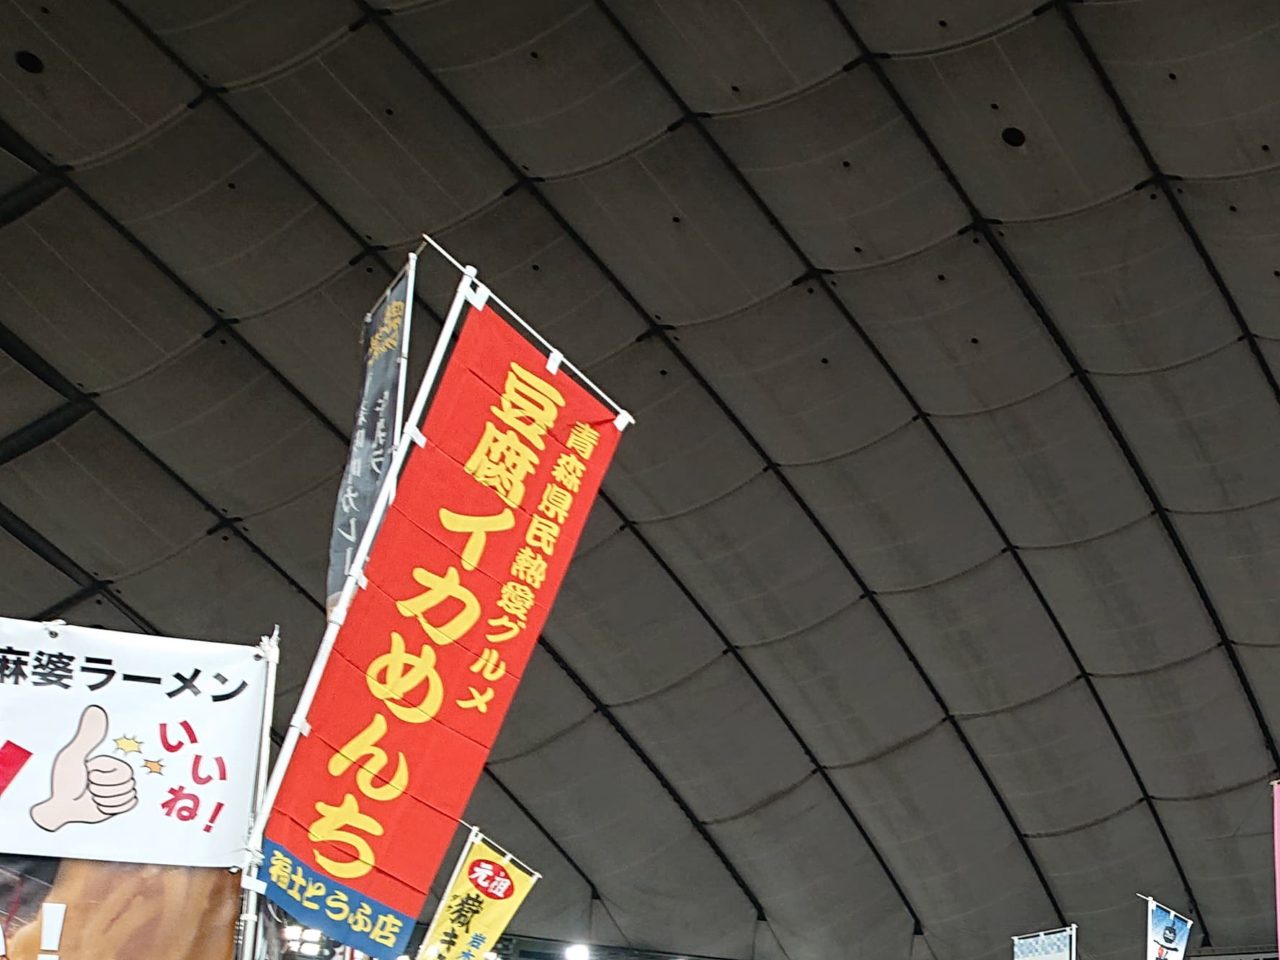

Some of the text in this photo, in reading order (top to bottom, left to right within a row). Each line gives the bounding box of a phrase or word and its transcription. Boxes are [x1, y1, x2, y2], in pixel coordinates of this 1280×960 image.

[309, 361, 567, 879] 豆腐イカめんち
[456, 420, 601, 714] 青森県民熱愛グルメ
[269, 850, 405, 950] 福士とうふ店
[469, 861, 512, 898] 元祖
